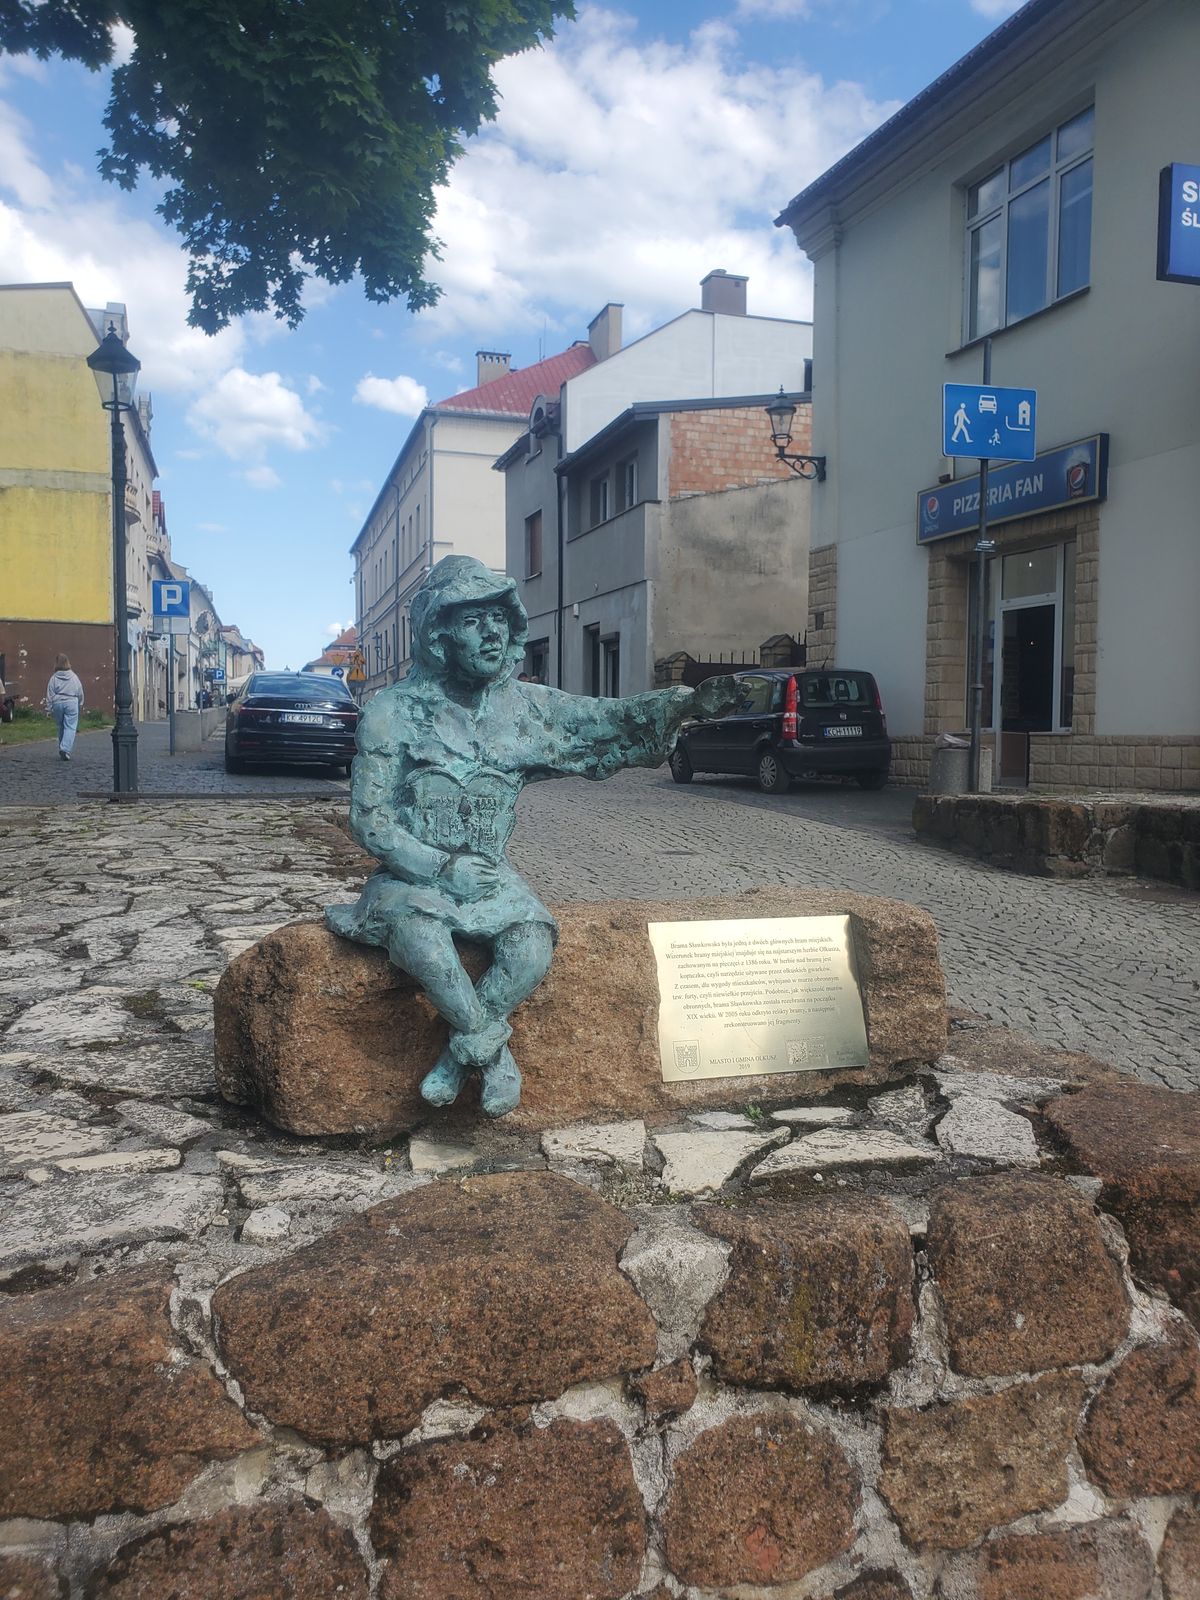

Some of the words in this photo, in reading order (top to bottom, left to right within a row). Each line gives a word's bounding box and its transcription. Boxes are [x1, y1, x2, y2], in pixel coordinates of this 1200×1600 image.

[1182, 180, 1200, 203] S
[1015, 474, 1044, 498] FAN
[161, 584, 182, 612] P
